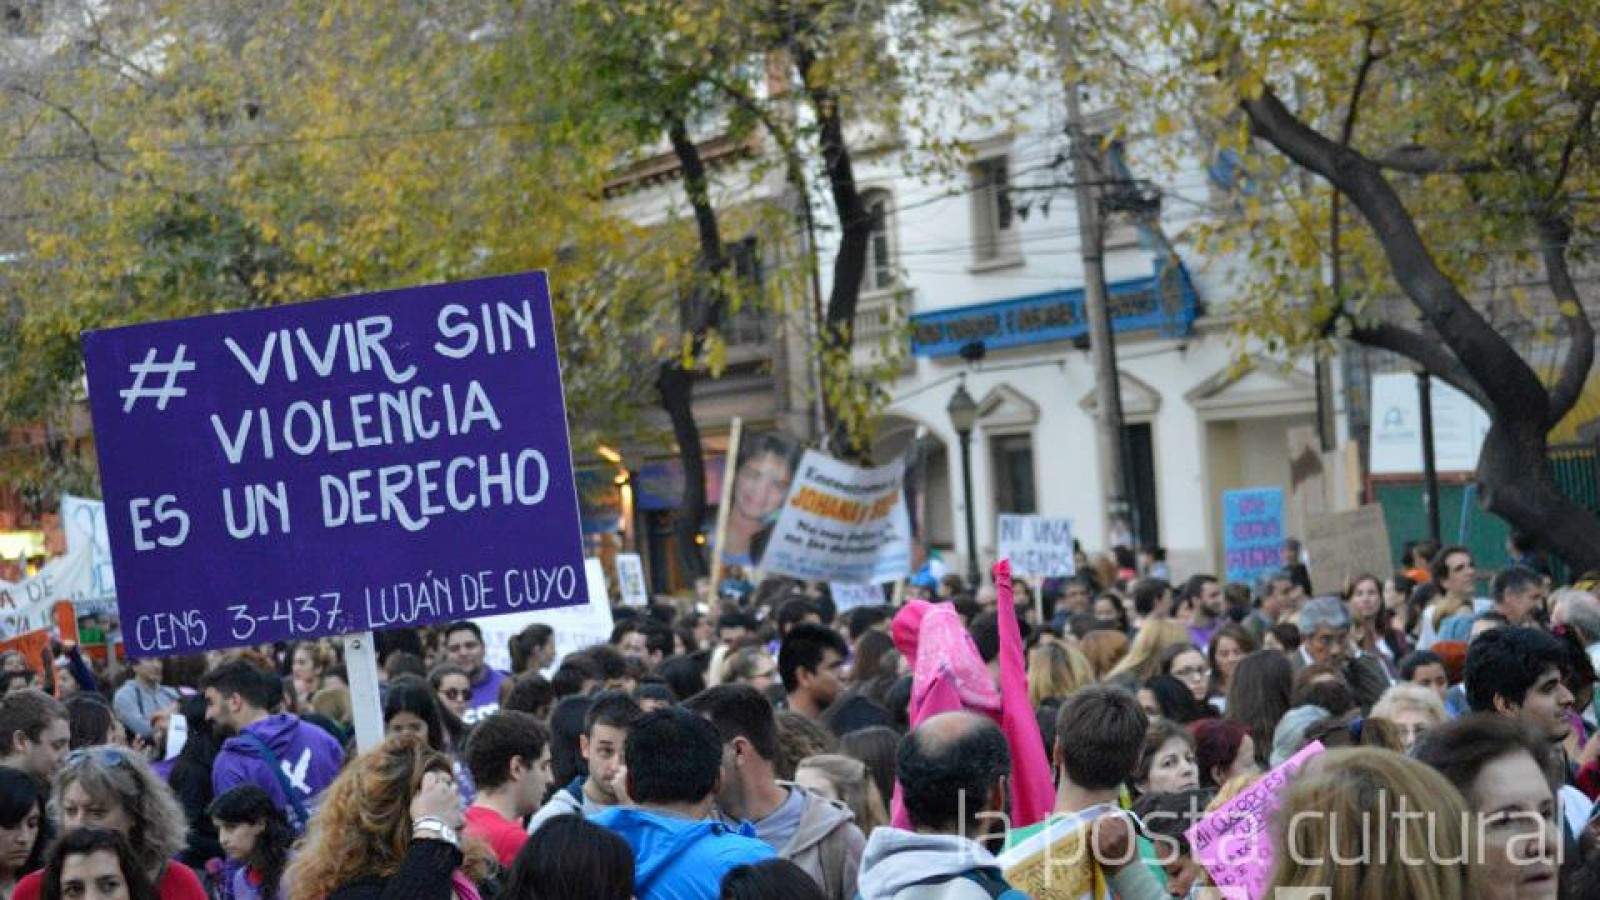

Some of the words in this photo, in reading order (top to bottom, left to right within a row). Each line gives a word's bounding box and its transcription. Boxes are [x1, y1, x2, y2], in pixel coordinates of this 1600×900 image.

[225, 315, 418, 384] VIVIR
[434, 299, 536, 359] SIN
[211, 380, 501, 464] VIOLENCIA
[129, 494, 191, 551] ES
[223, 481, 291, 539] UN
[320, 449, 551, 531] DERECHO
[1001, 518, 1023, 542] NI
[1034, 519, 1072, 545] UNA
[136, 609, 207, 651] CENS
[365, 570, 452, 628] LUJÁN
[461, 570, 497, 611] DE
[505, 564, 576, 608] CUYO
